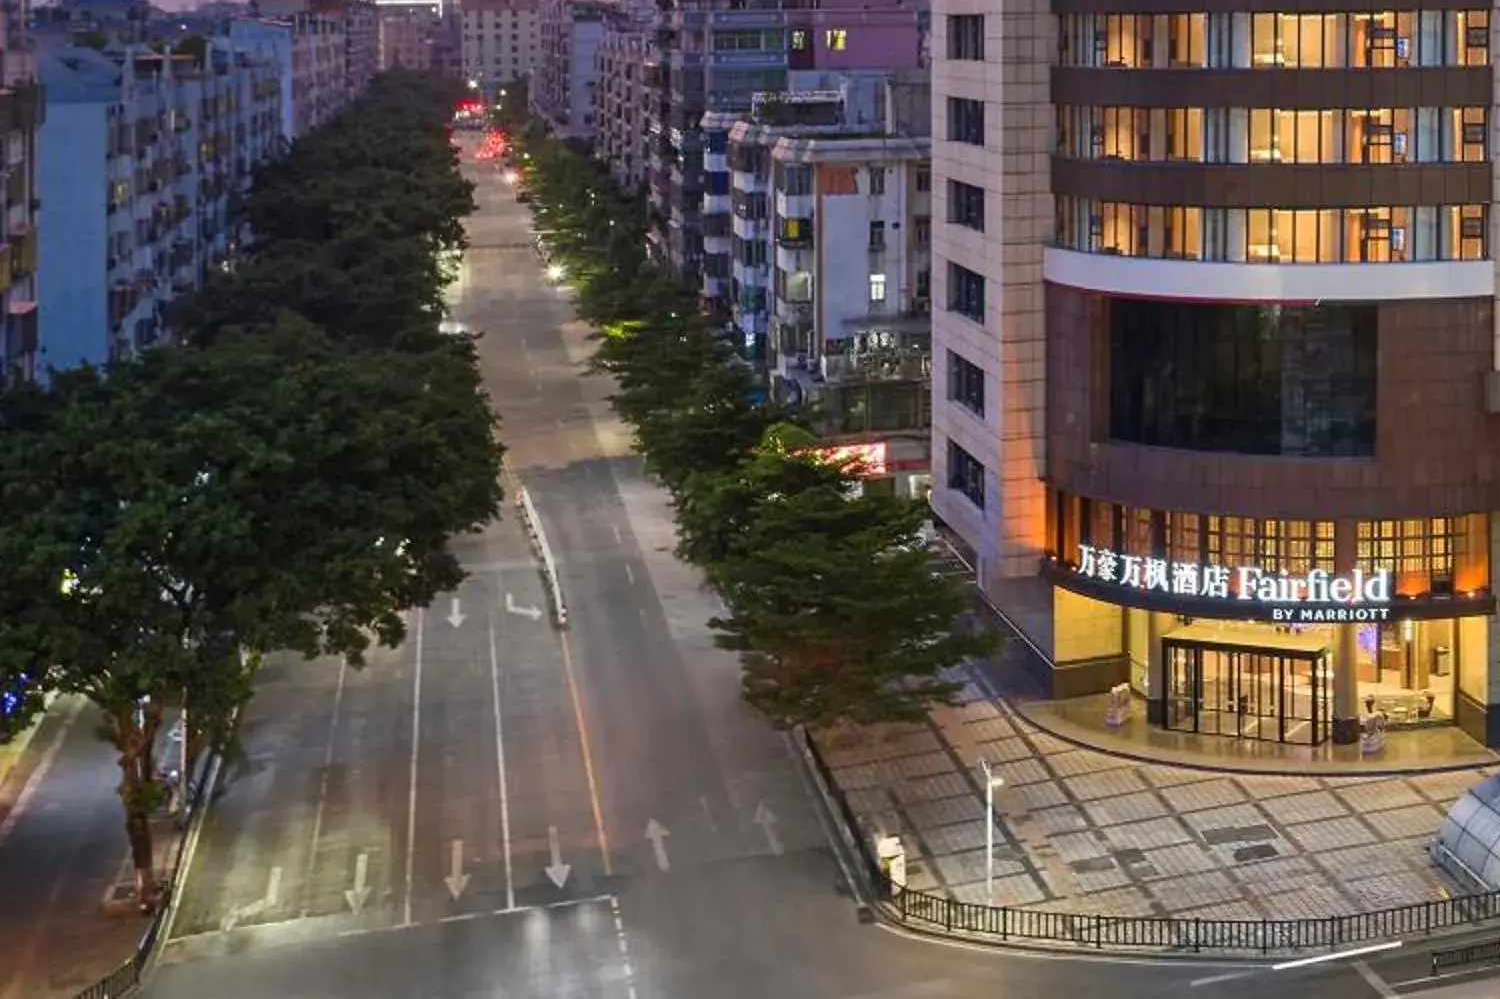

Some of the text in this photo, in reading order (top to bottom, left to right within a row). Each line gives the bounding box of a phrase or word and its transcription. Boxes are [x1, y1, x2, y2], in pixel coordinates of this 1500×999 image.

[1078, 544, 1230, 599] 万豪万枫酒店
[1237, 566, 1389, 603] Fairfield
[1273, 607, 1390, 621] BY MARRIOTT
